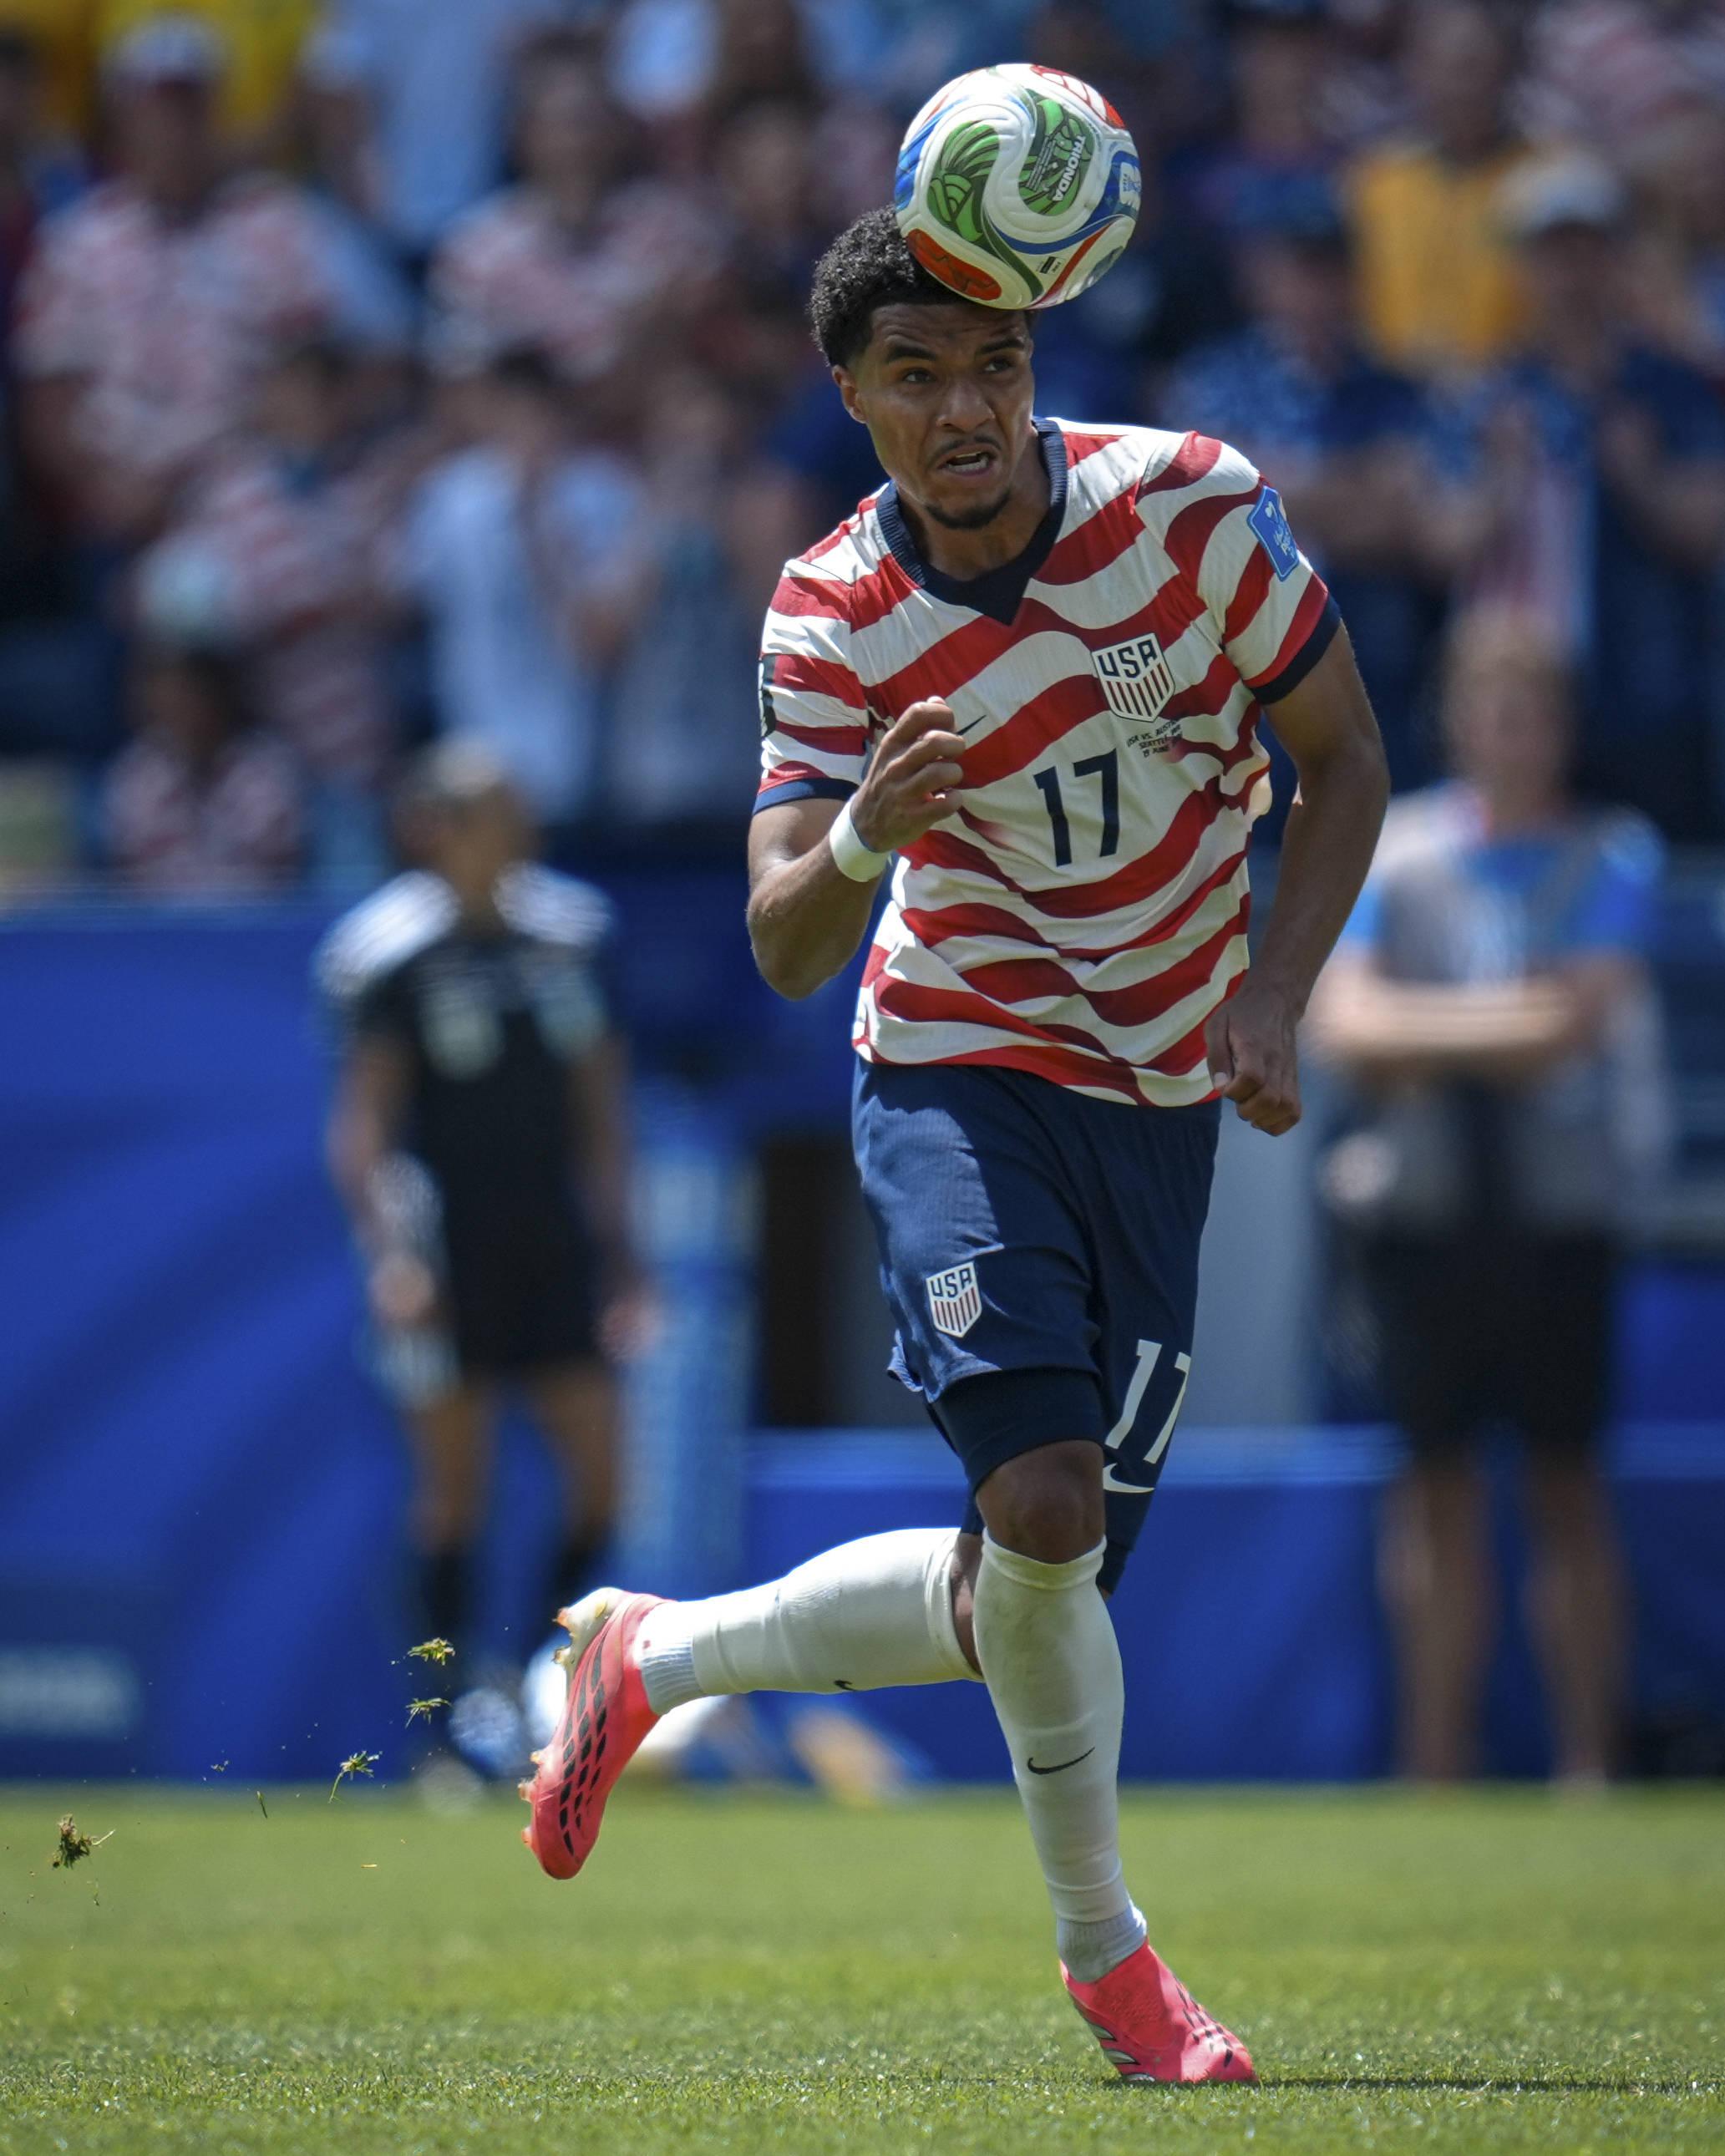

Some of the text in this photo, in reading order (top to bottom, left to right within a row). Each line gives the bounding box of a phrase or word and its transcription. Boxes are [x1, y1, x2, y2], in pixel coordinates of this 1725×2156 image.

[1053, 135, 1086, 201] TRIONDA
[1097, 639, 1158, 679] USA
[1033, 748, 1119, 867] 17
[930, 1266, 973, 1298] USA
[1104, 1338, 1192, 1464] 17
